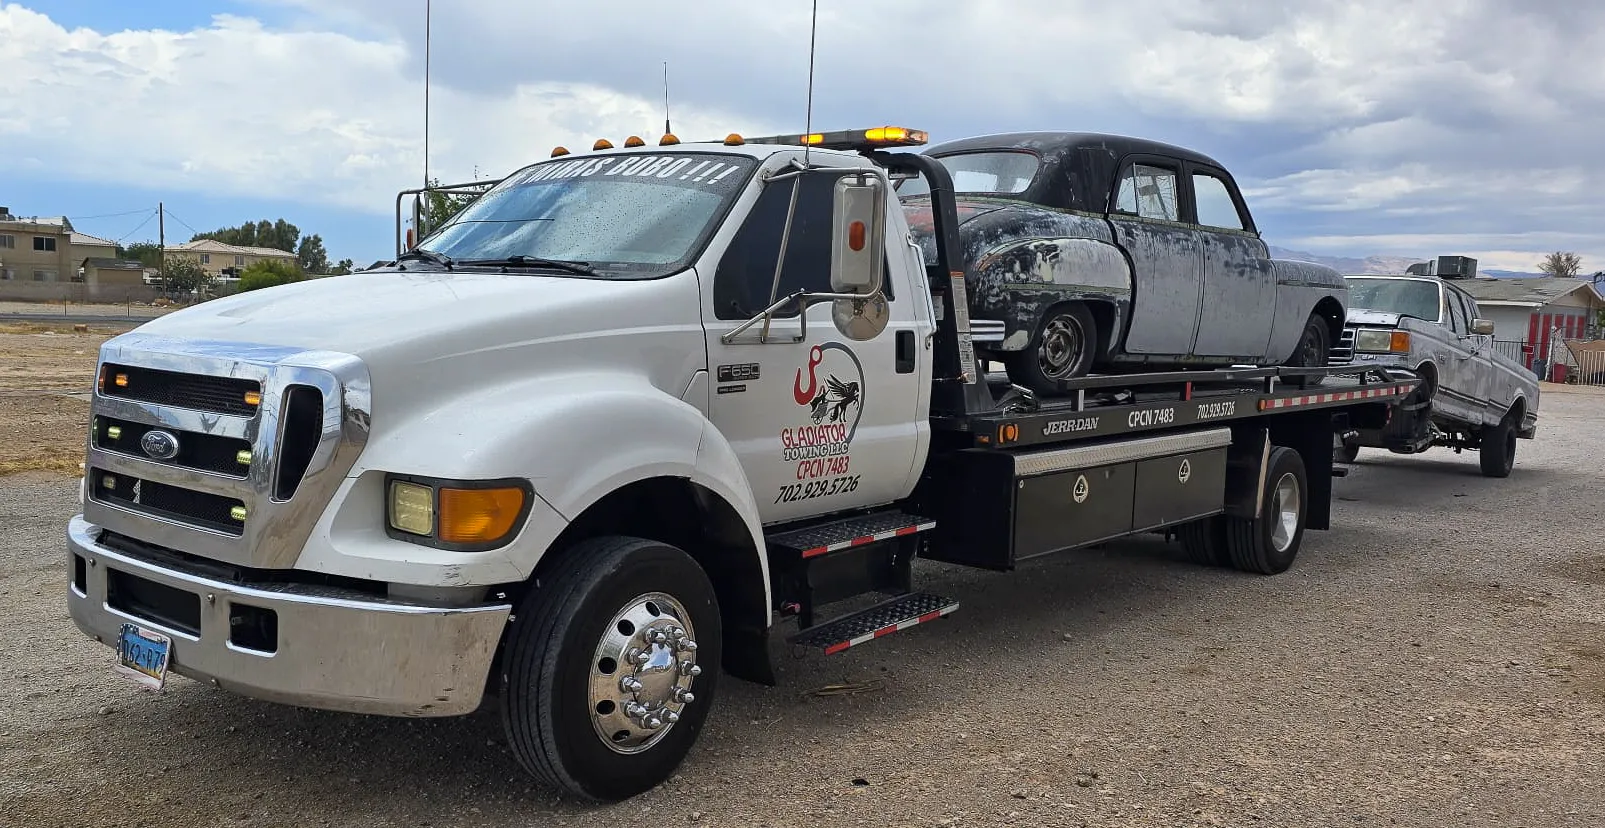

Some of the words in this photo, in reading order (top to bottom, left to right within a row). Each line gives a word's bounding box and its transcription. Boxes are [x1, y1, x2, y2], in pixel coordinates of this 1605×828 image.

[719, 364, 760, 377] F650
[1128, 410, 1152, 428] CPCN
[1153, 408, 1174, 424] 7483
[1197, 401, 1235, 420] 702.929.5726
[144, 434, 166, 453] Ford
[781, 423, 846, 448] GLADIATOR
[784, 445, 828, 461] TOWING
[829, 442, 849, 456] LLC
[796, 460, 825, 480] CPCN
[826, 456, 850, 477] 7483
[774, 475, 860, 504] 702.929.5726
